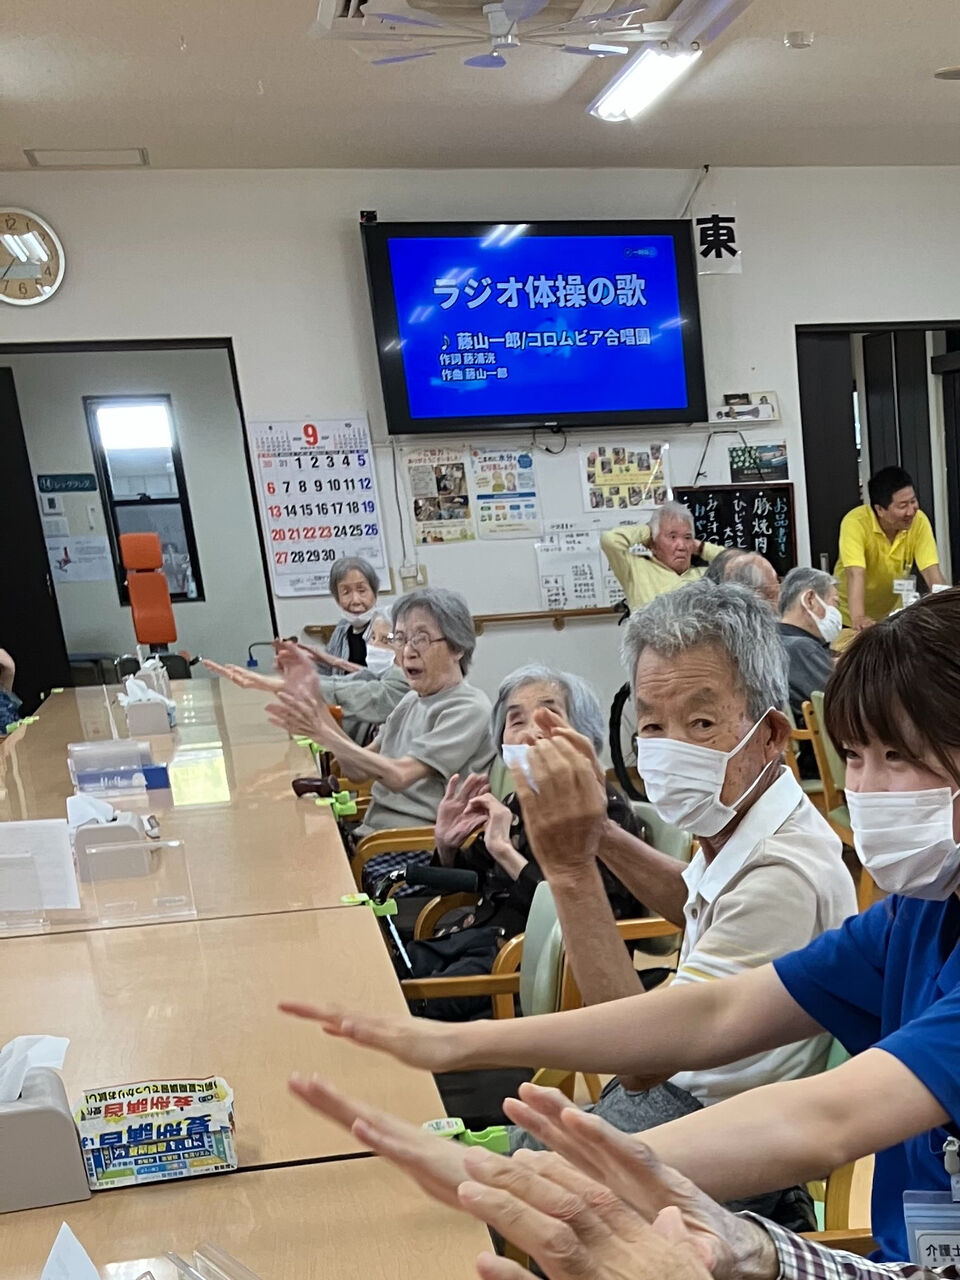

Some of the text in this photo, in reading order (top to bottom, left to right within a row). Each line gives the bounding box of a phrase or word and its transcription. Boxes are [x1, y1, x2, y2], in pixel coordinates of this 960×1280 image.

[696, 214, 739, 259] 東
[18, 282, 28, 296] 6
[433, 273, 647, 309] ラジオ体操の歌
[303, 424, 318, 446] 9
[295, 458, 302, 469] 1
[311, 457, 319, 468] 2
[326, 456, 335, 468] 3
[342, 455, 350, 467] 4
[358, 454, 366, 466] 5
[267, 478, 372, 494] 6 7 8 9 10 11 12
[268, 501, 375, 518] 13 14 15 16 17 18 19
[272, 524, 378, 541] 20 21 22 23 24 25 26
[752, 497, 773, 554] 豚焼肉
[275, 549, 335, 564] 27 28 29 30
